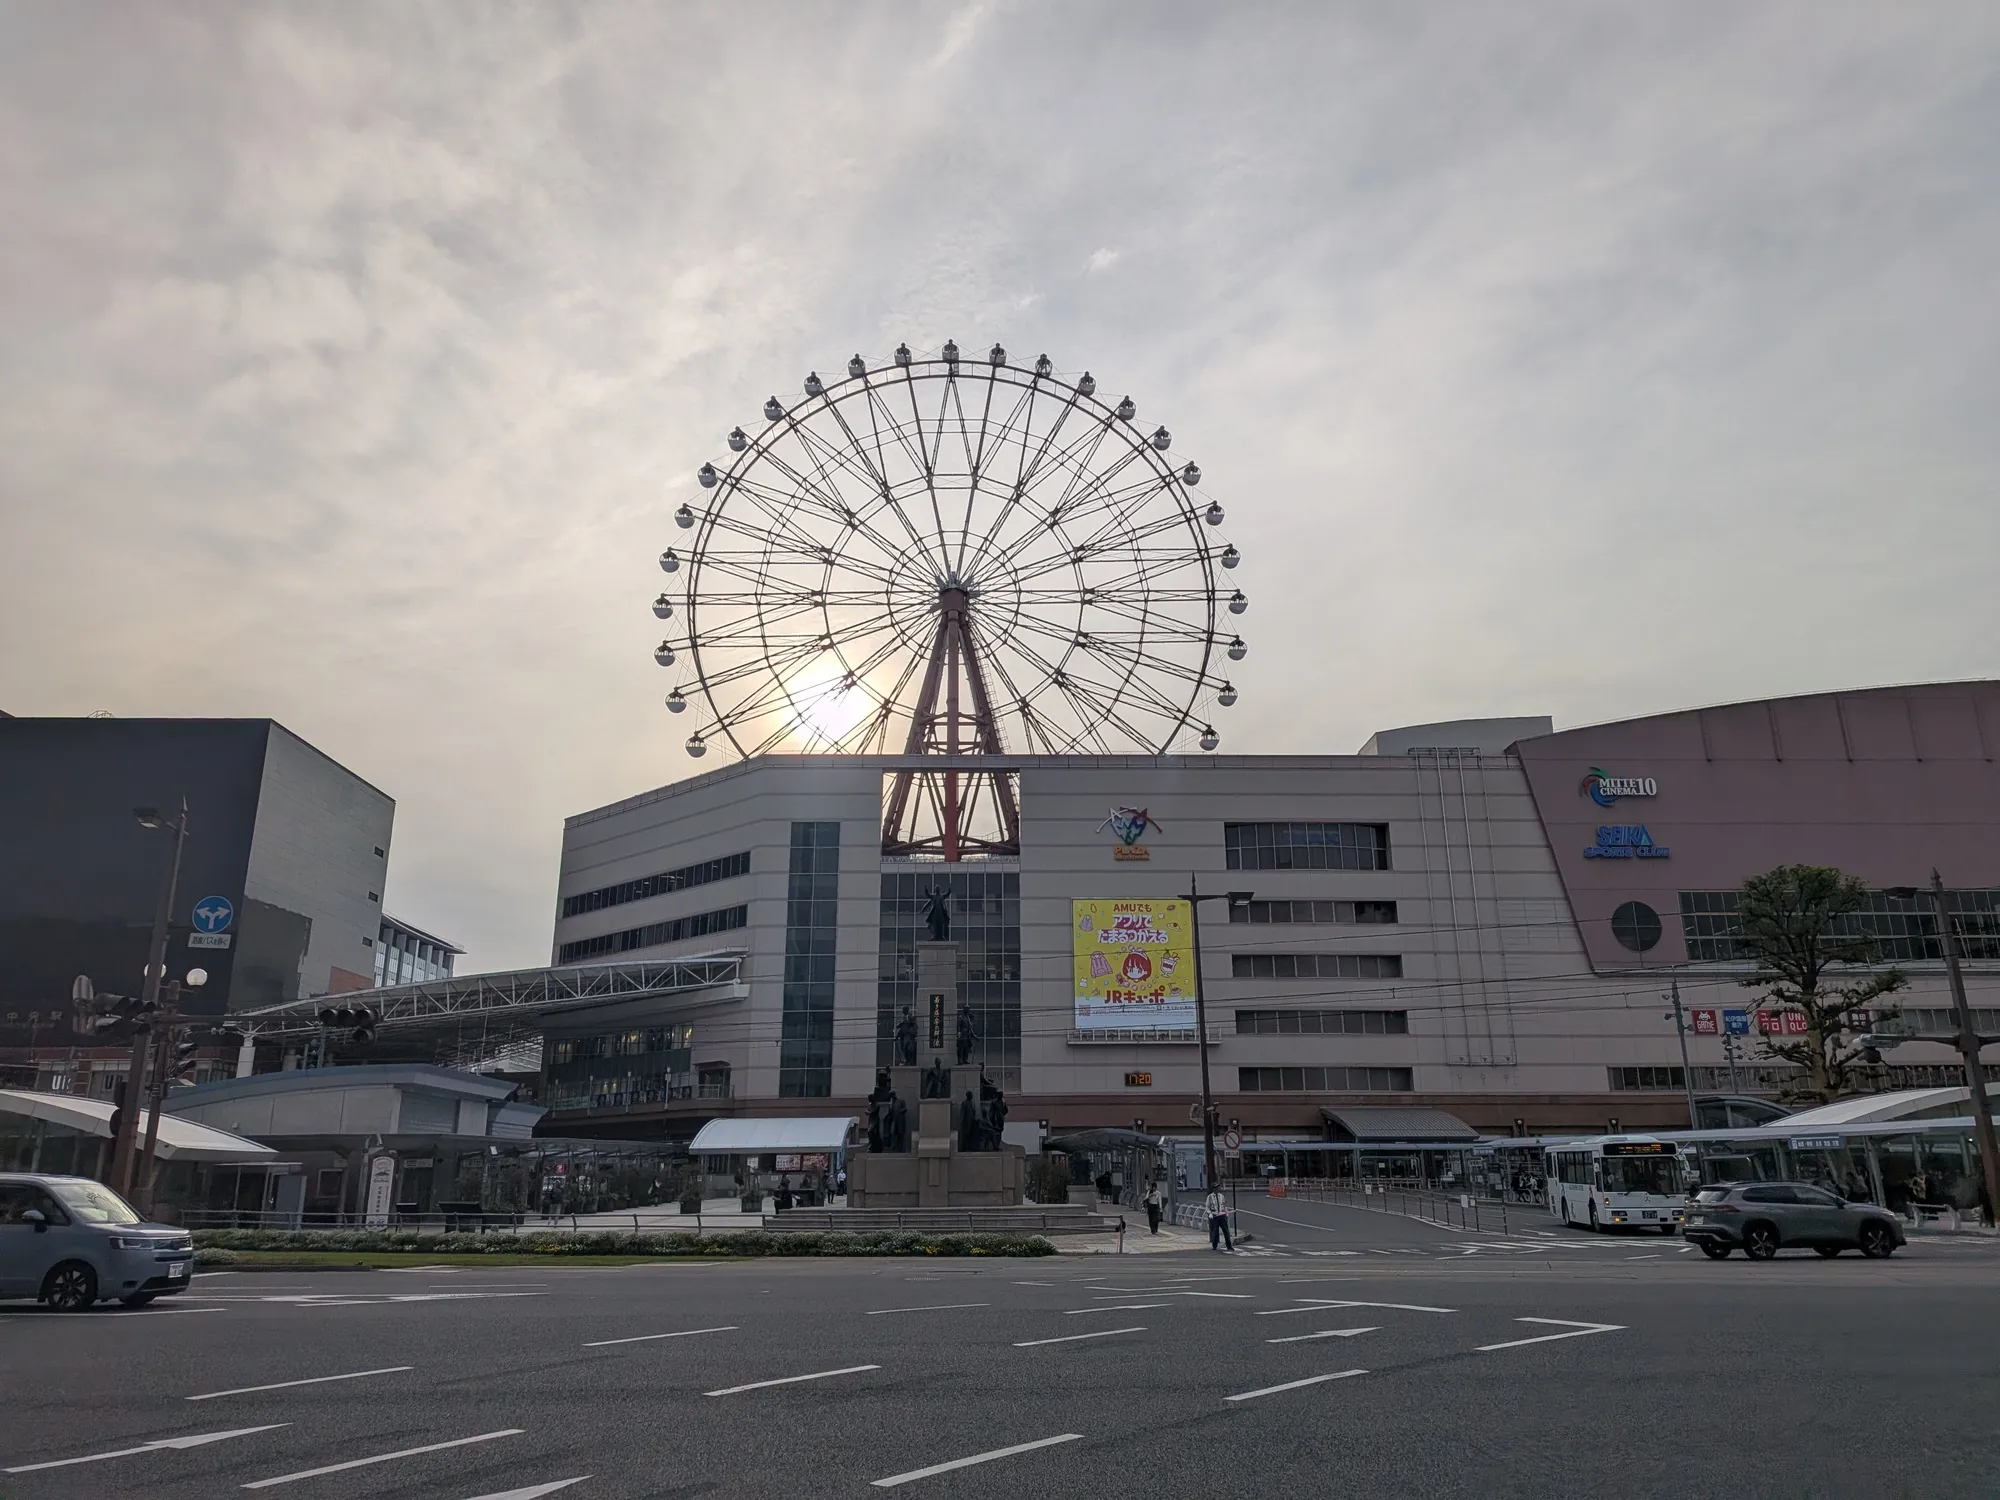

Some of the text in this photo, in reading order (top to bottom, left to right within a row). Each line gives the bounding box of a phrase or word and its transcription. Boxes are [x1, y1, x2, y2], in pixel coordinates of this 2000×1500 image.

[1599, 778, 1637, 788] MITTE
[1634, 777, 1657, 796] 10
[1600, 787, 1637, 796] CINEMA
[1597, 823, 1657, 846] SEIKA
[1113, 903, 1152, 912] AMUでも
[1112, 914, 1153, 928] アプリで
[1104, 985, 1166, 1004] JRキューポ
[1129, 1074, 1151, 1085] 17:20
